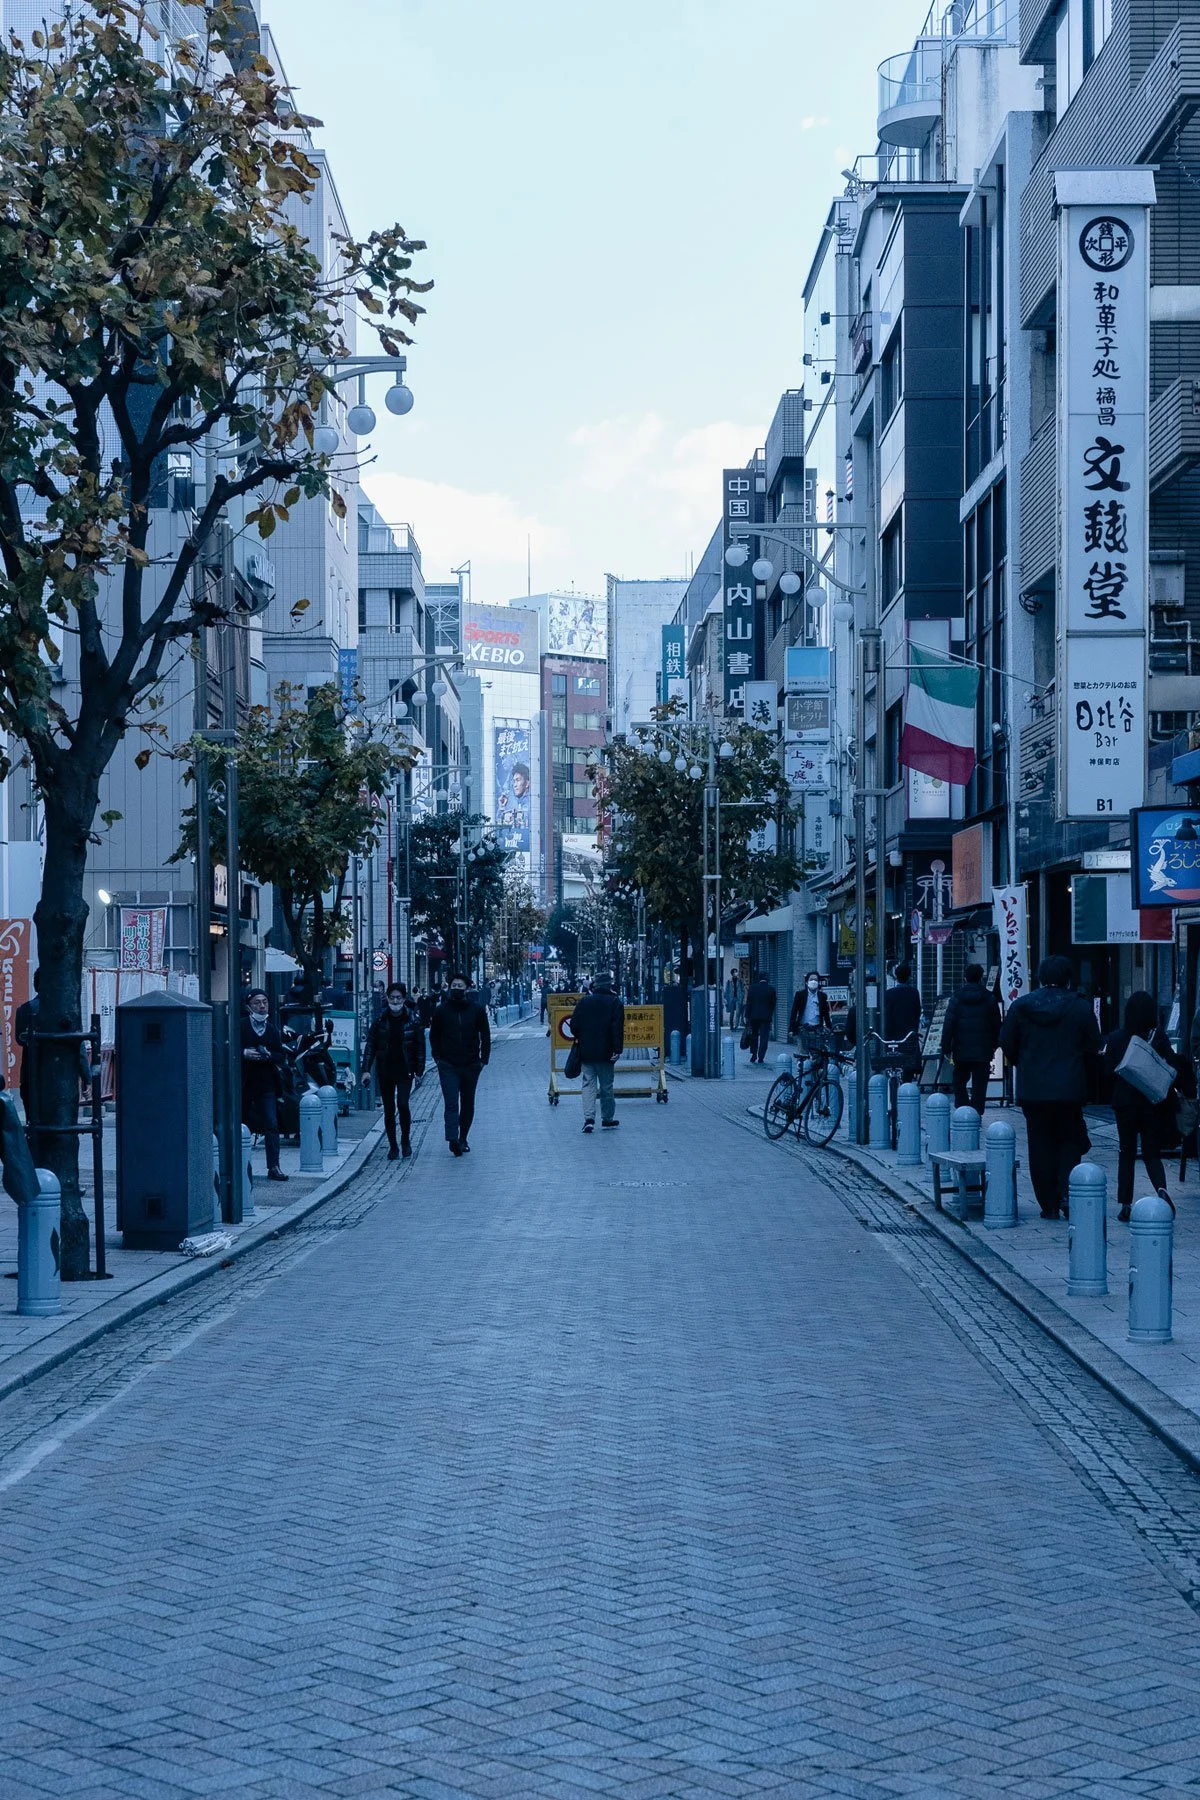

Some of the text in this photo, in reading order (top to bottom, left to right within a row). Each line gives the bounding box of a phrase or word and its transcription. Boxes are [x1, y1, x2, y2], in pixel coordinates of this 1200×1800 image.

[1092, 282, 1121, 379] 和菓子処
[464, 621, 520, 645] SPORTS
[466, 643, 525, 665] XEBIO
[666, 642, 681, 679] 相鉄
[793, 700, 823, 710] 小学館
[1076, 697, 1134, 732] 日比谷
[1094, 732, 1118, 748] Bar
[1089, 758, 1120, 766] 神保町店
[1097, 799, 1113, 811] B1
